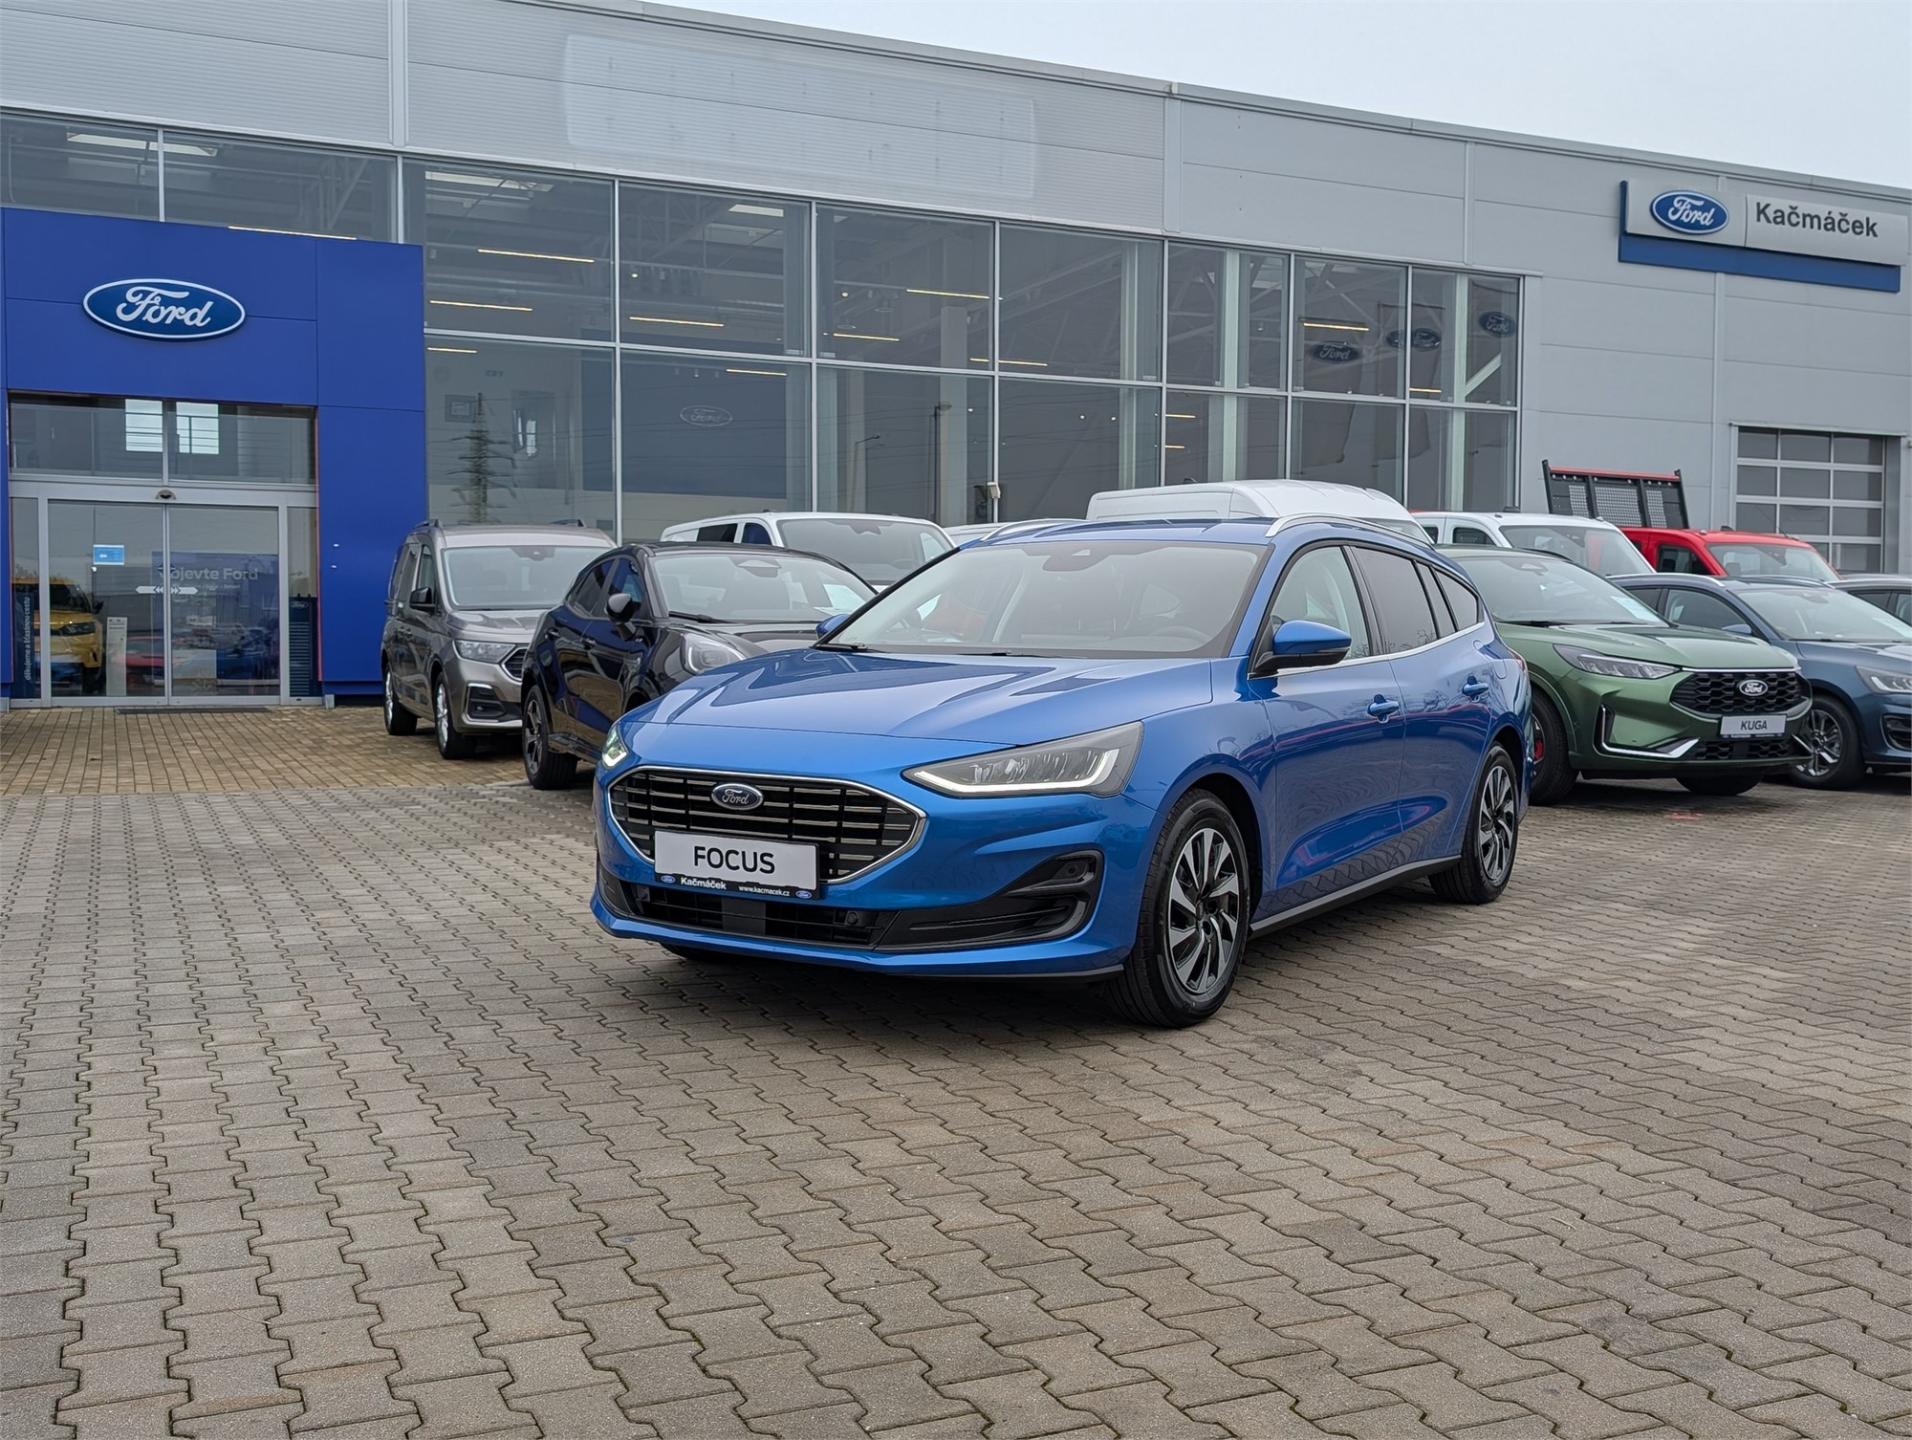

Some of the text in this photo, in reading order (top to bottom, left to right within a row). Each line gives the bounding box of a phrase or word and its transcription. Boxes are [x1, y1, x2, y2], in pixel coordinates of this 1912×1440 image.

[1668, 196, 1878, 238] Ford Kačmáček
[116, 286, 214, 327] Ford
[223, 567, 259, 580] Ford
[1744, 682, 1763, 693] Ford
[1740, 720, 1768, 730] KUGA
[721, 788, 750, 805] Ford
[693, 845, 776, 875] FOCUS
[680, 877, 727, 890] Kačmáček
[738, 884, 791, 897] www.kacmacek.cz
